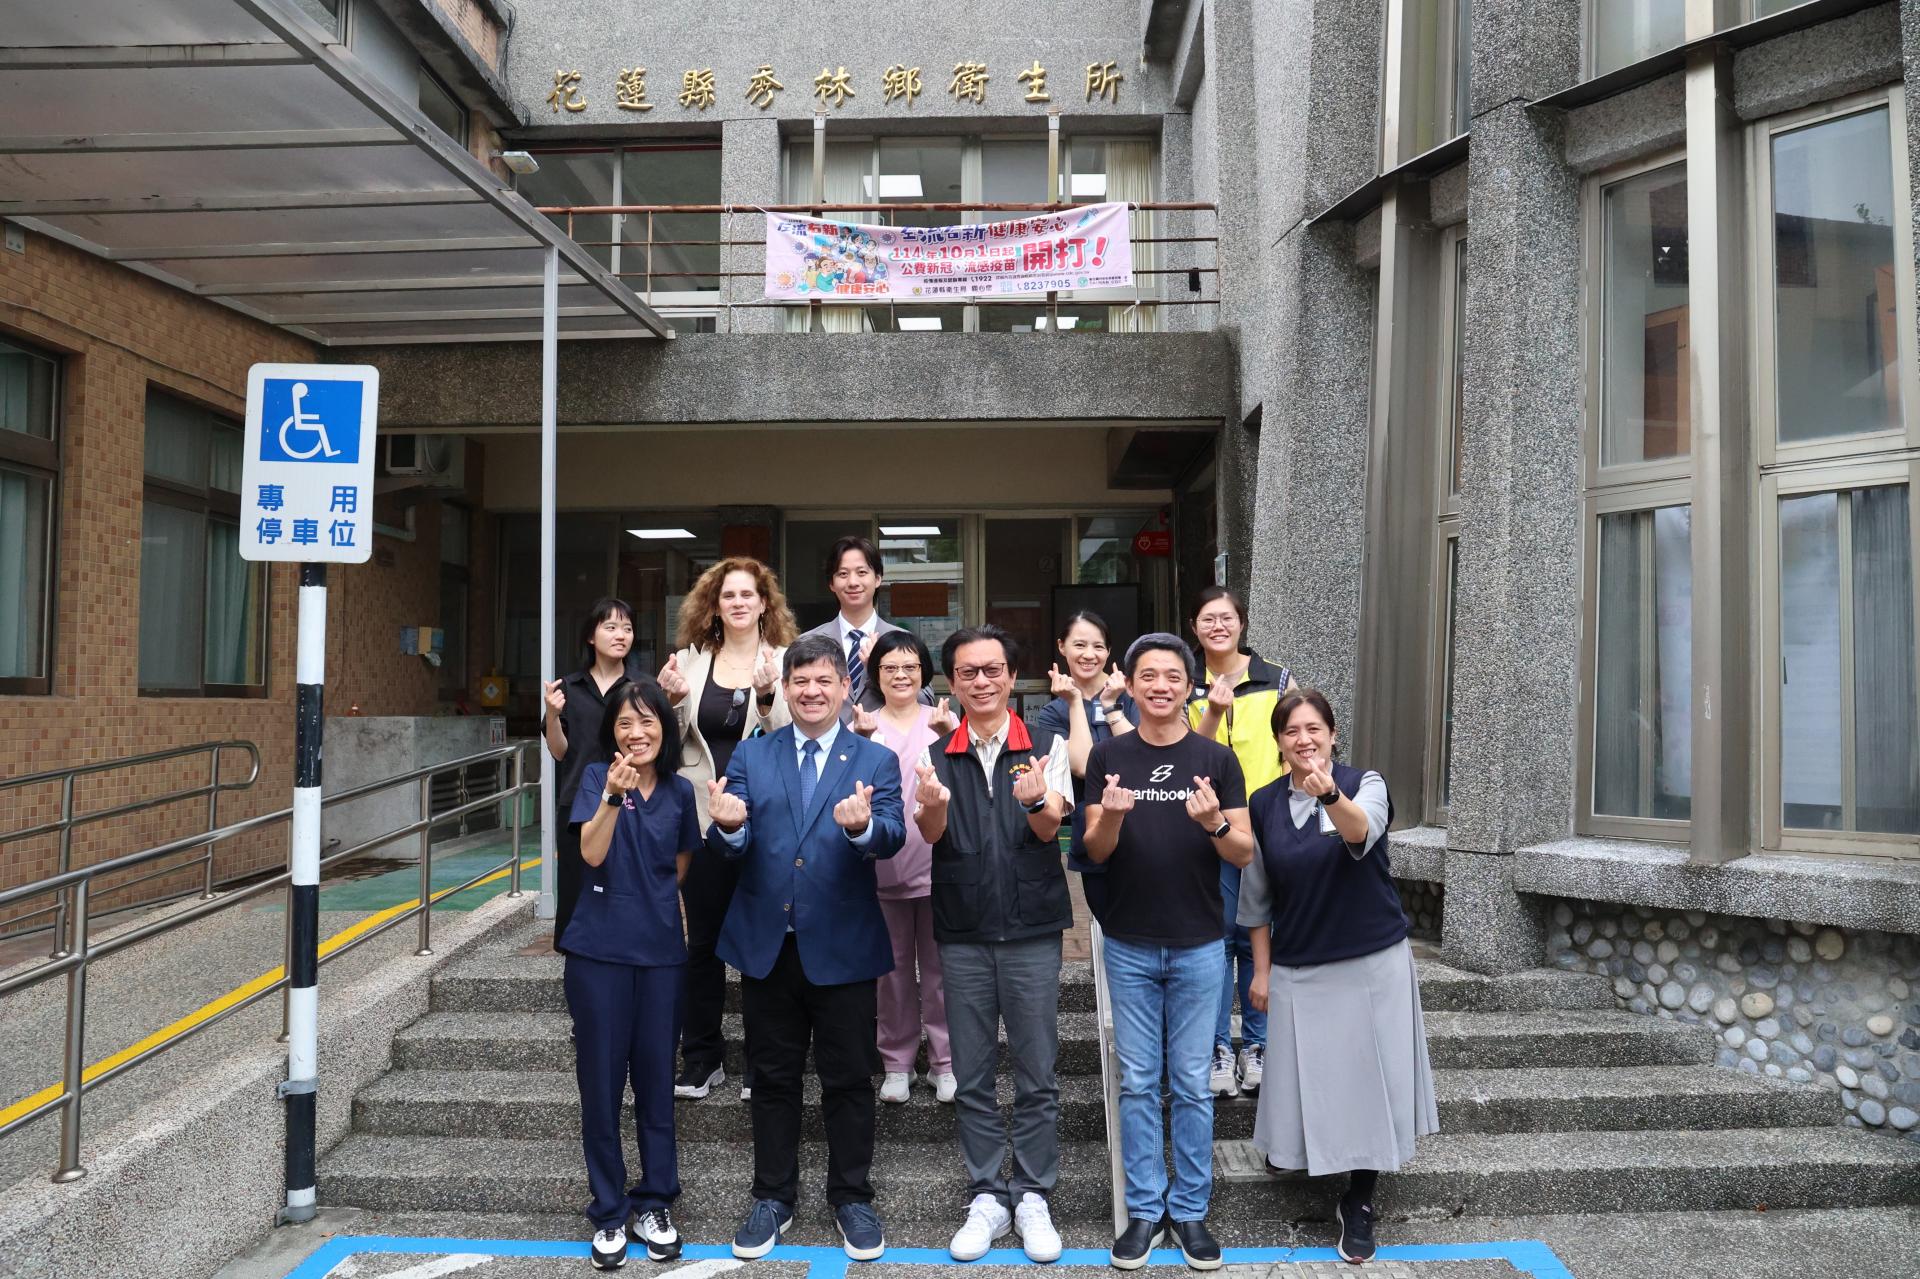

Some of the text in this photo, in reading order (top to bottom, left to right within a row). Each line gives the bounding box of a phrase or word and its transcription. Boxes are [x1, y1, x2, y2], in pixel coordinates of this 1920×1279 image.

[546, 59, 1125, 112] 花蓮縣秀林鄉衛生所
[901, 258, 1016, 275] 公費新冠、流感疫苗
[836, 282, 890, 295] 健康安心
[1023, 279, 1071, 290] 8237905
[256, 517, 356, 547] 停車位
[1133, 787, 1195, 802] arthbook
